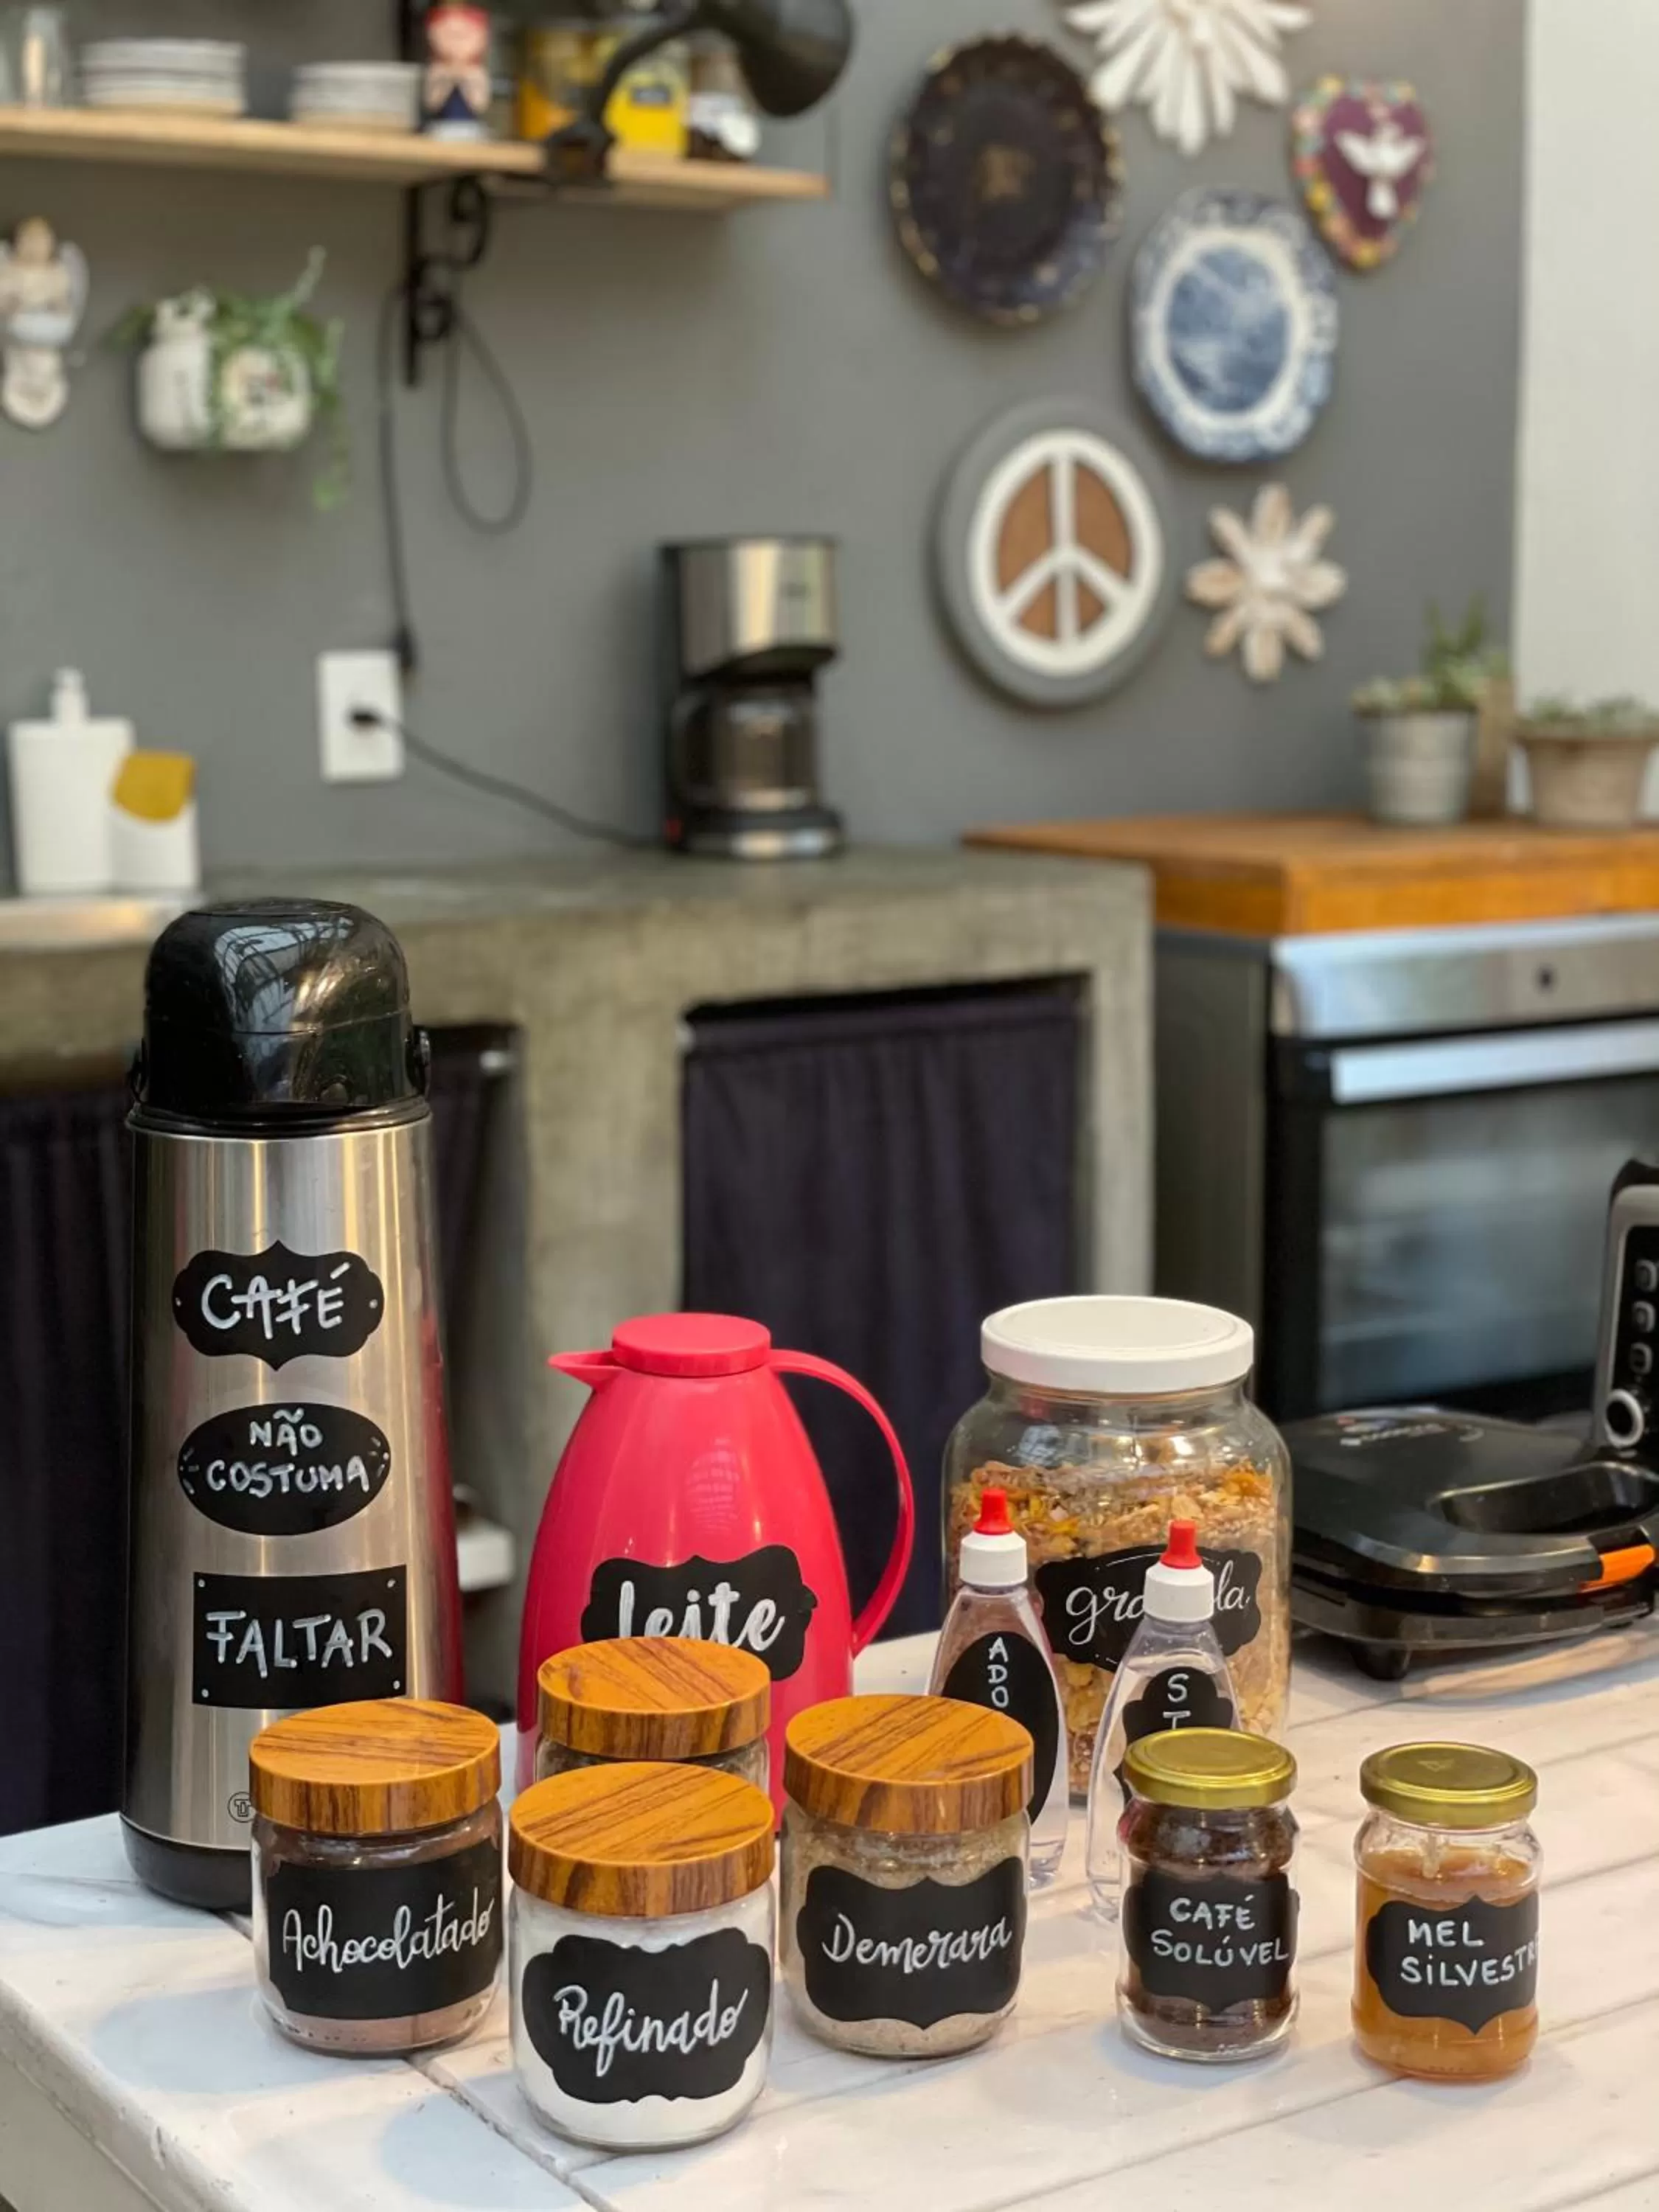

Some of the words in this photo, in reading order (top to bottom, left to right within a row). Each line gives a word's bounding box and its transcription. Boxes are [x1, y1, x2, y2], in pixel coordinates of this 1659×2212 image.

[201, 1262, 350, 1339] CAFÉ
[249, 1408, 322, 1455] NÃO
[207, 1455, 369, 1498] COSTUMA
[207, 1608, 392, 1678] FALTAR
[282, 1888, 495, 1973] Achocolatado
[1169, 1894, 1256, 1930] CAFÉ
[1408, 1919, 1484, 1947] MEL
[821, 1913, 1012, 1974] Demerara
[1150, 1929, 1289, 1966] SOLÚVEL
[554, 1979, 748, 2077] Refinado
